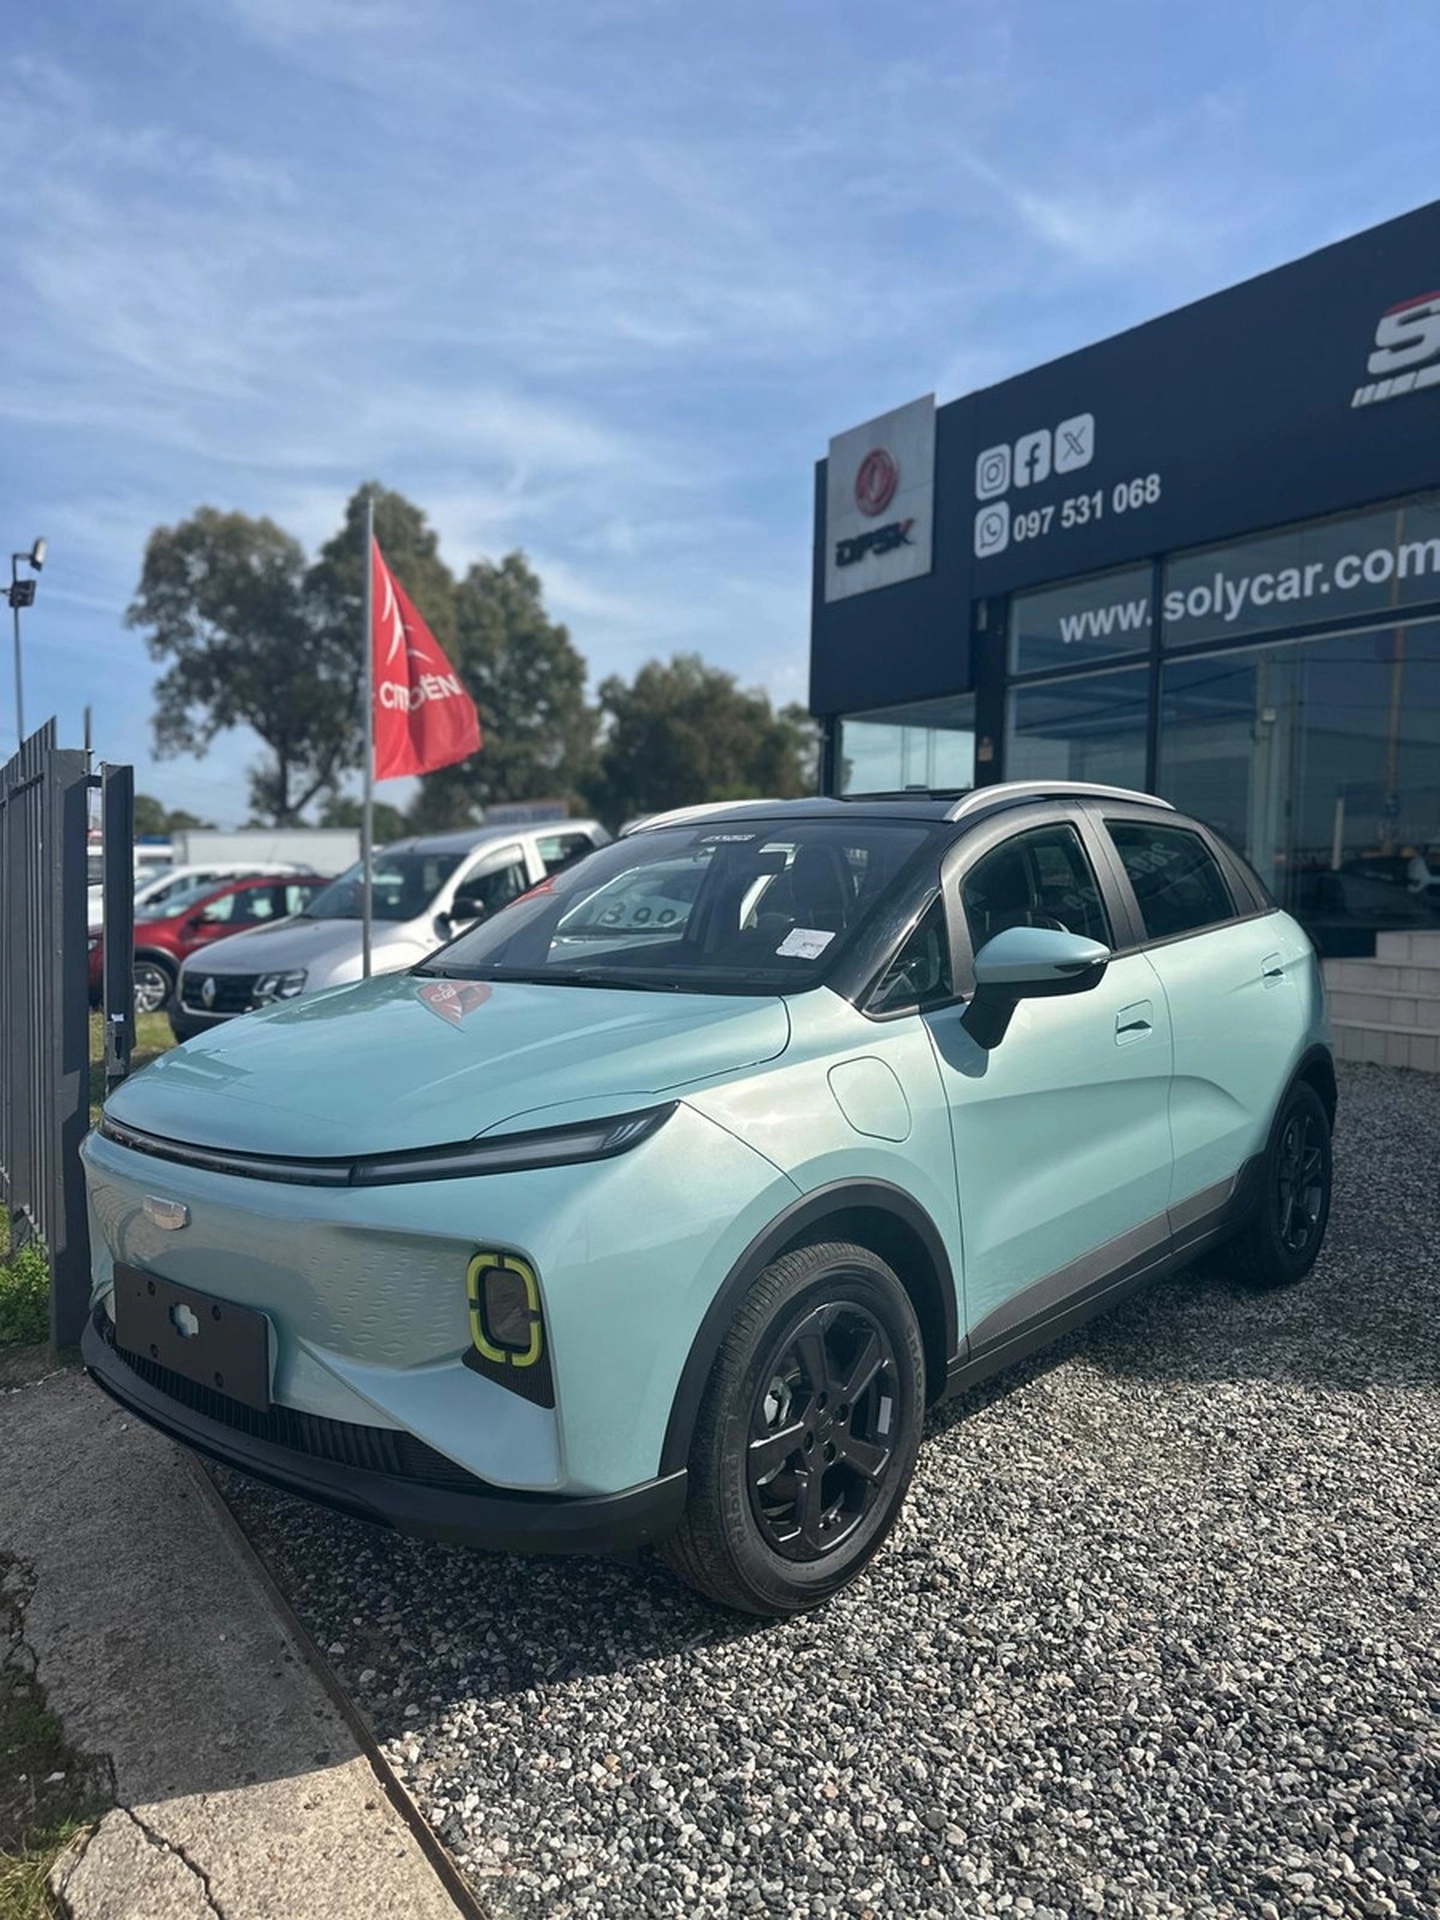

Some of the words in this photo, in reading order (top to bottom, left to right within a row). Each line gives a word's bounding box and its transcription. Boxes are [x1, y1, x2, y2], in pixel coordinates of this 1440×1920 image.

[1013, 505, 1054, 542] 097
[1061, 489, 1104, 529] 531
[1113, 473, 1161, 514] 068
